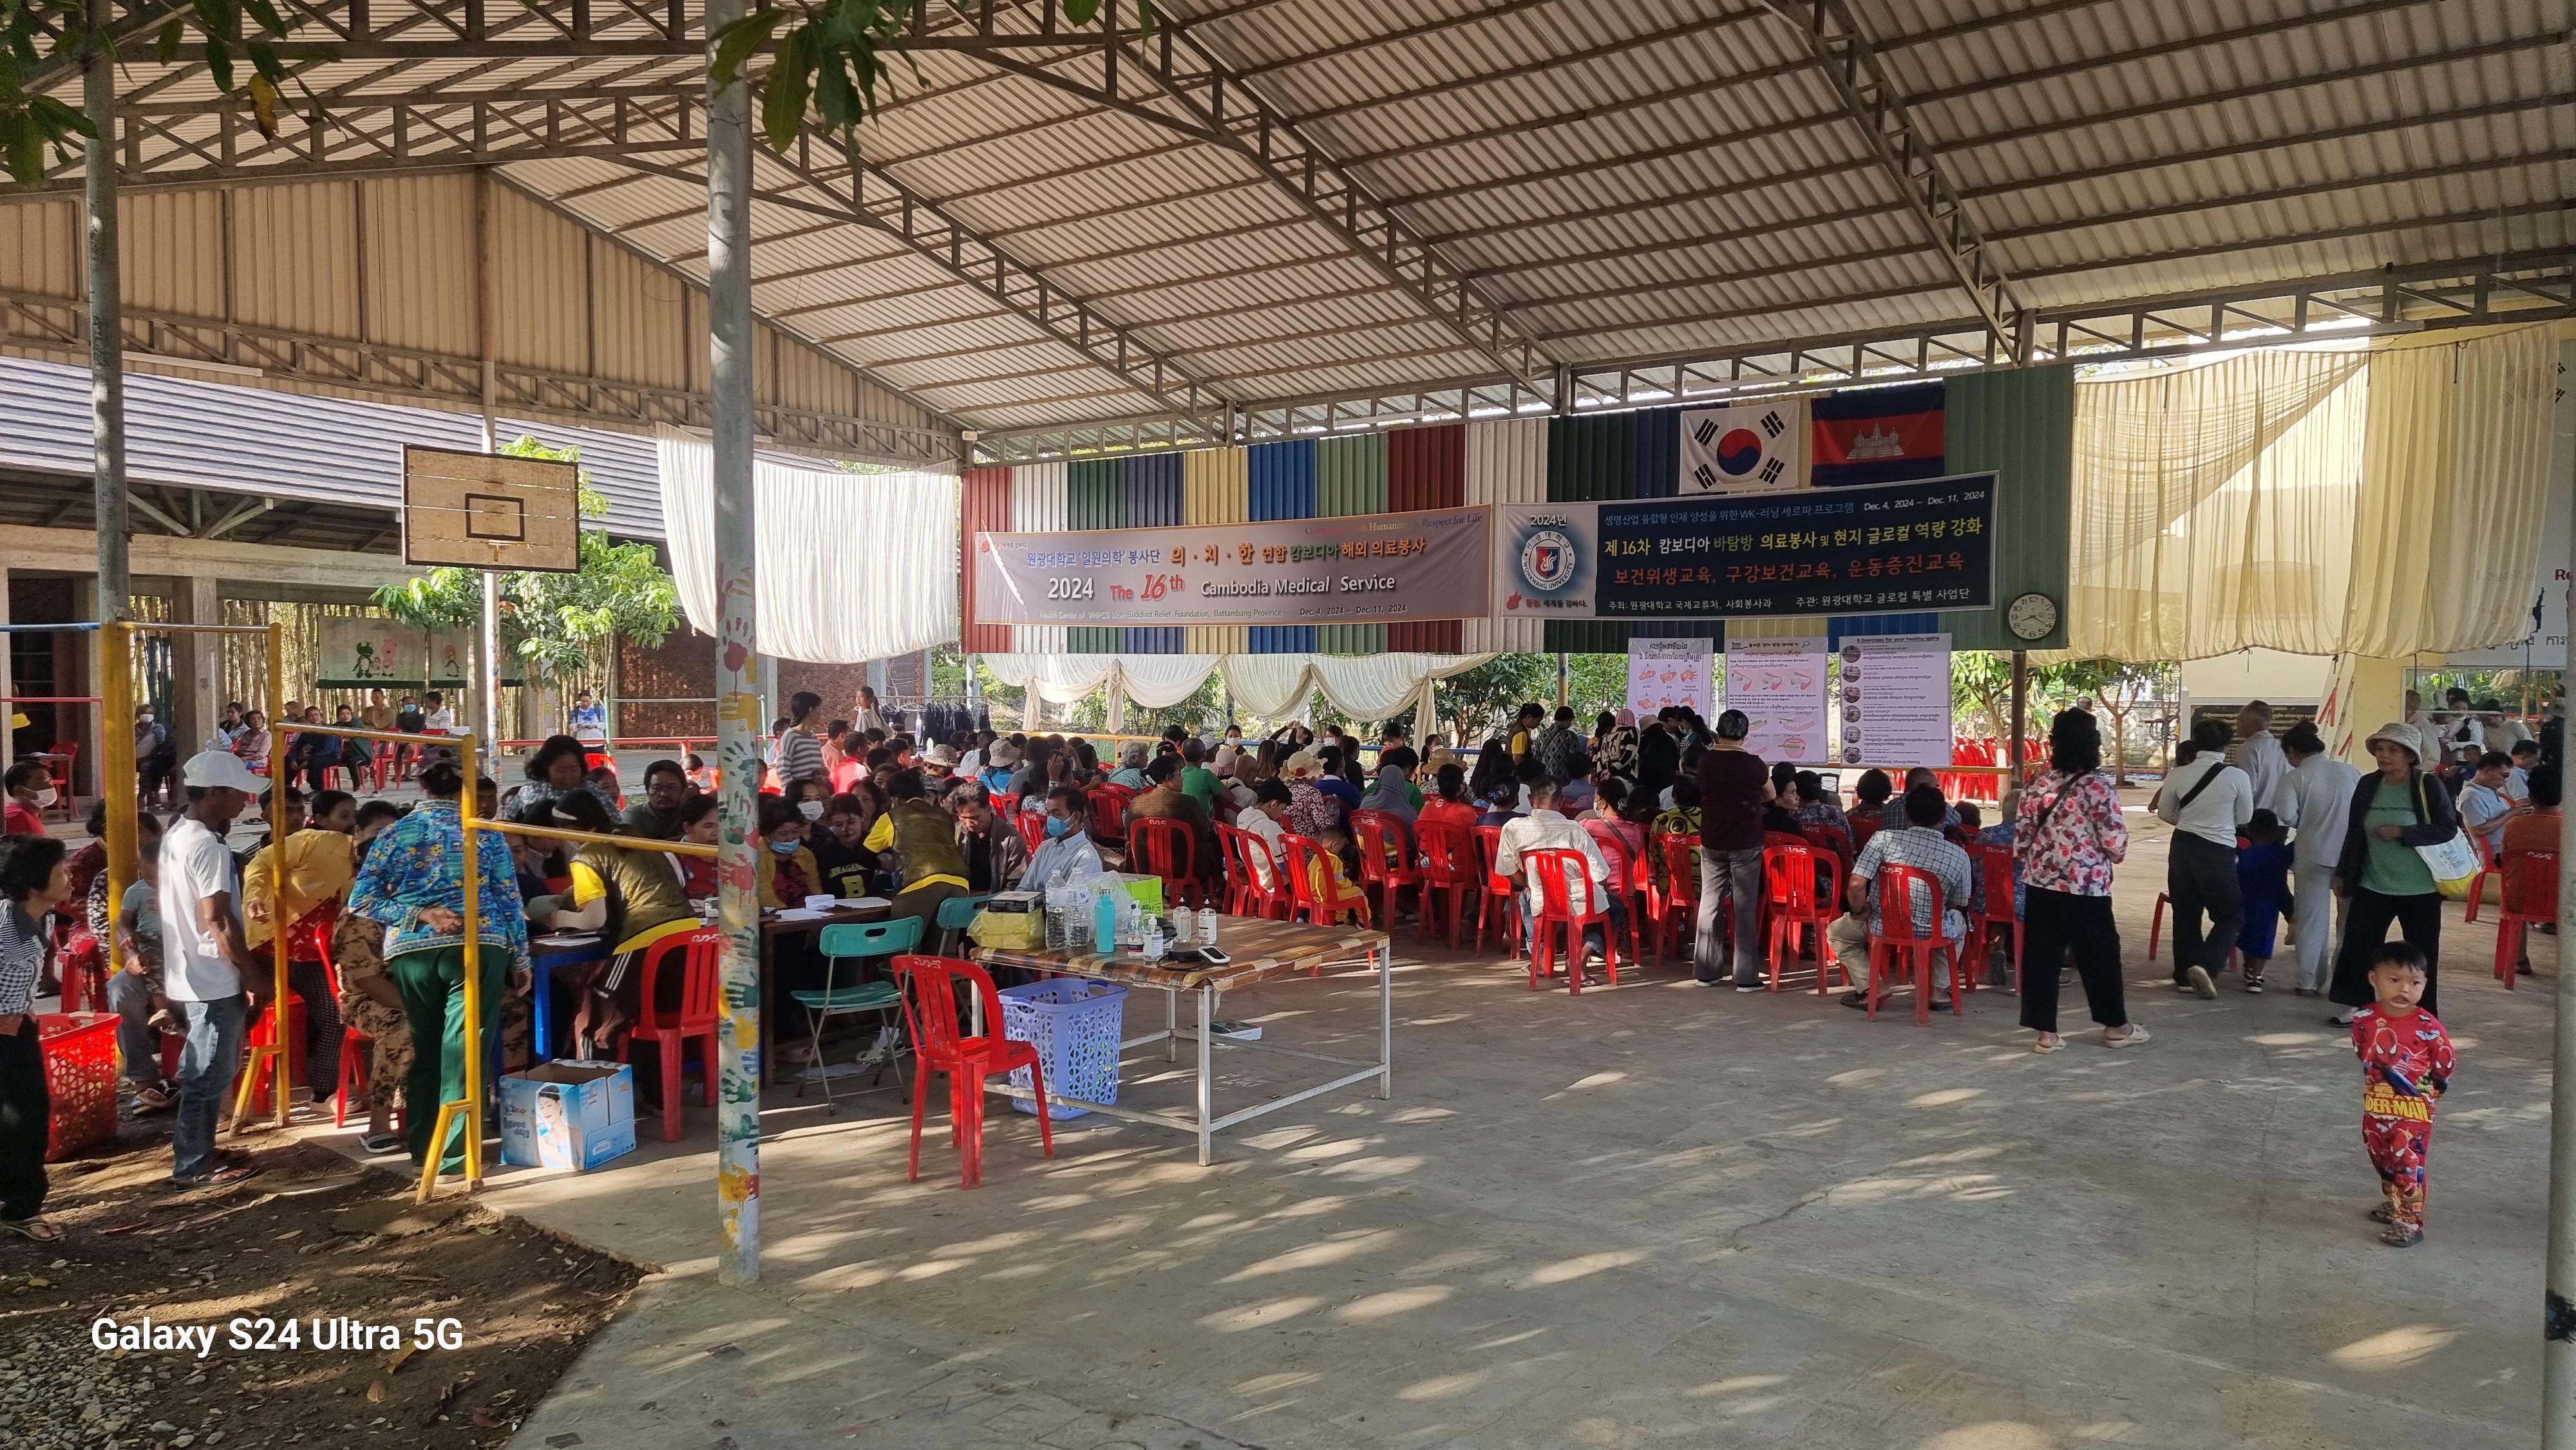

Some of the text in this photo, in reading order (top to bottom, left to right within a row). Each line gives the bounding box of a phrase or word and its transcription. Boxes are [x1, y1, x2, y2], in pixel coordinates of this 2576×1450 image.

[1895, 499, 1914, 509] 2024
[1964, 491, 1984, 500] 2024
[1454, 516, 1464, 525] for
[1467, 513, 1482, 523] Life
[1530, 513, 1567, 527] 2024년
[1605, 514, 1639, 526] 생명산업
[1642, 514, 1667, 525] 융합형
[1670, 513, 1687, 523] 인재
[1690, 511, 1717, 523] 양성을
[1719, 509, 1738, 520] 위한
[1781, 505, 1812, 516] 세르파
[1814, 502, 1854, 514] 프로그램
[1605, 517, 1983, 556] 제 16차 캄보디아 바탐방 의료봉사 및 현지 글로컬 역량 강화
[1027, 551, 1076, 567] 원광대학교
[1128, 548, 1160, 565] 봉사단
[1170, 545, 1186, 566] 의
[1204, 544, 1219, 566] 치
[1238, 542, 1255, 564] 한
[1262, 545, 1287, 563] 연합
[1290, 542, 1340, 561] 캄보디아
[1341, 540, 1368, 559] 해외
[1371, 537, 1426, 556] 의료봉사
[1524, 561, 1573, 588] WONKWANG UNIVERSITY
[1615, 551, 1964, 585] 보건위생교육, 구강보건교육, 운동증진교육
[1048, 577, 1094, 599] 2024
[1110, 585, 1134, 601] The
[1200, 578, 1269, 596] Cambodia
[1274, 576, 1330, 594] Medical
[1340, 573, 1396, 592] Service
[1609, 587, 1970, 610] 주최: 원광대학교 국제교류처, 사회봉사과 주관: 원광대학교 글로컬 특별 사업단
[1112, 610, 1154, 619] Won-Buddhist
[1175, 610, 1210, 618] Foundation,
[1214, 608, 1251, 619] Battambang
[1327, 607, 1343, 615] 2024
[1373, 605, 1384, 614] 11,
[1389, 604, 1406, 612] 2024
[842, 875, 866, 898] B
